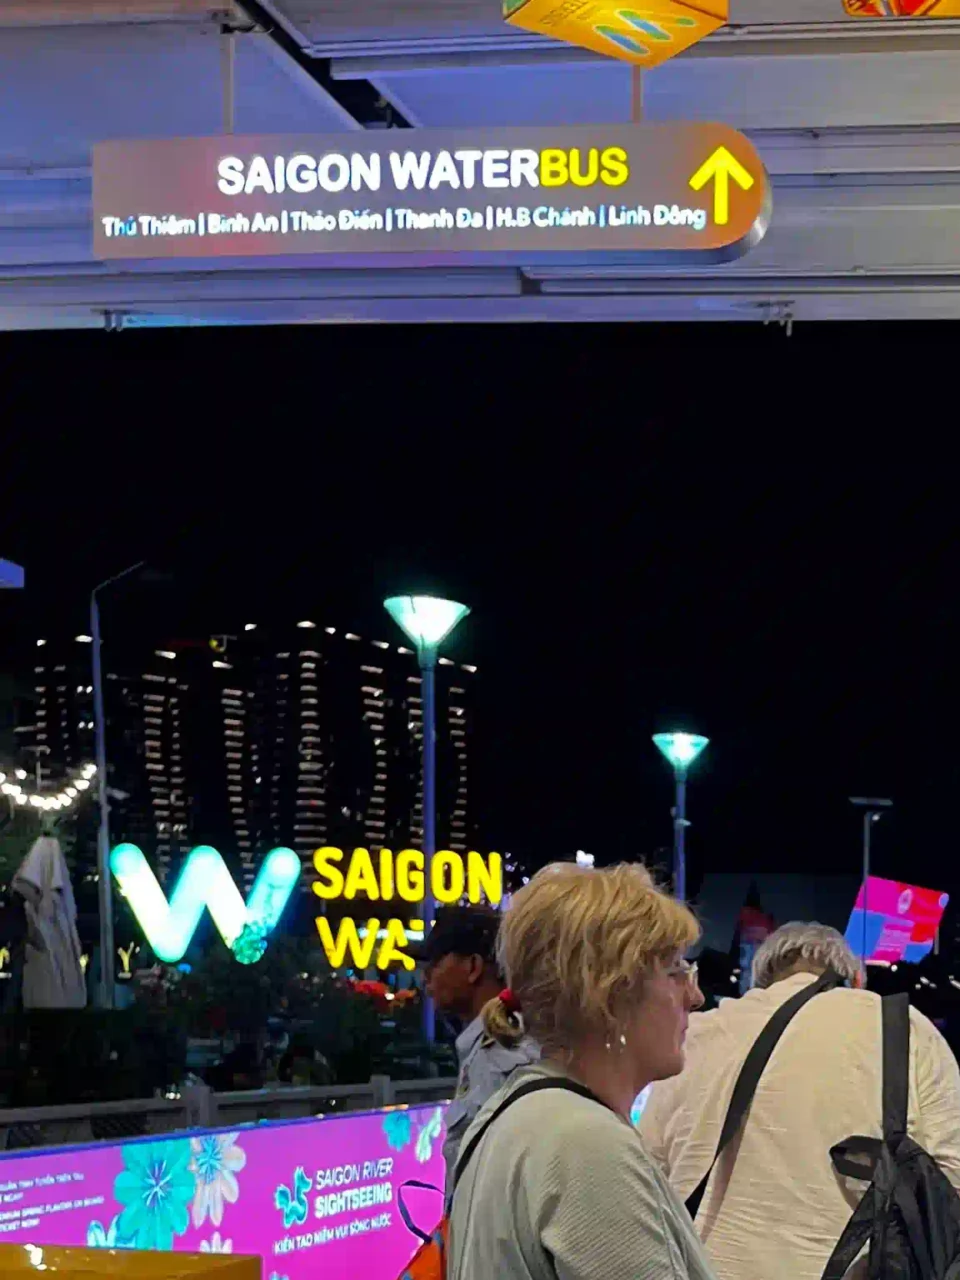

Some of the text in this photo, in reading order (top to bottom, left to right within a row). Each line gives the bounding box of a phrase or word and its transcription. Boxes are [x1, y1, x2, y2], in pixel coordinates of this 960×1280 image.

[217, 147, 629, 195] SAIGON WATERBUS
[251, 211, 279, 233] An
[395, 207, 451, 230] Thanh
[495, 207, 531, 228] H.B
[608, 204, 650, 226] Linh
[311, 846, 502, 905] SAIGON
[315, 915, 436, 971] WA
[315, 1157, 394, 1191] SAIGON RIVER
[314, 1181, 393, 1219] SIGHTSEEING
